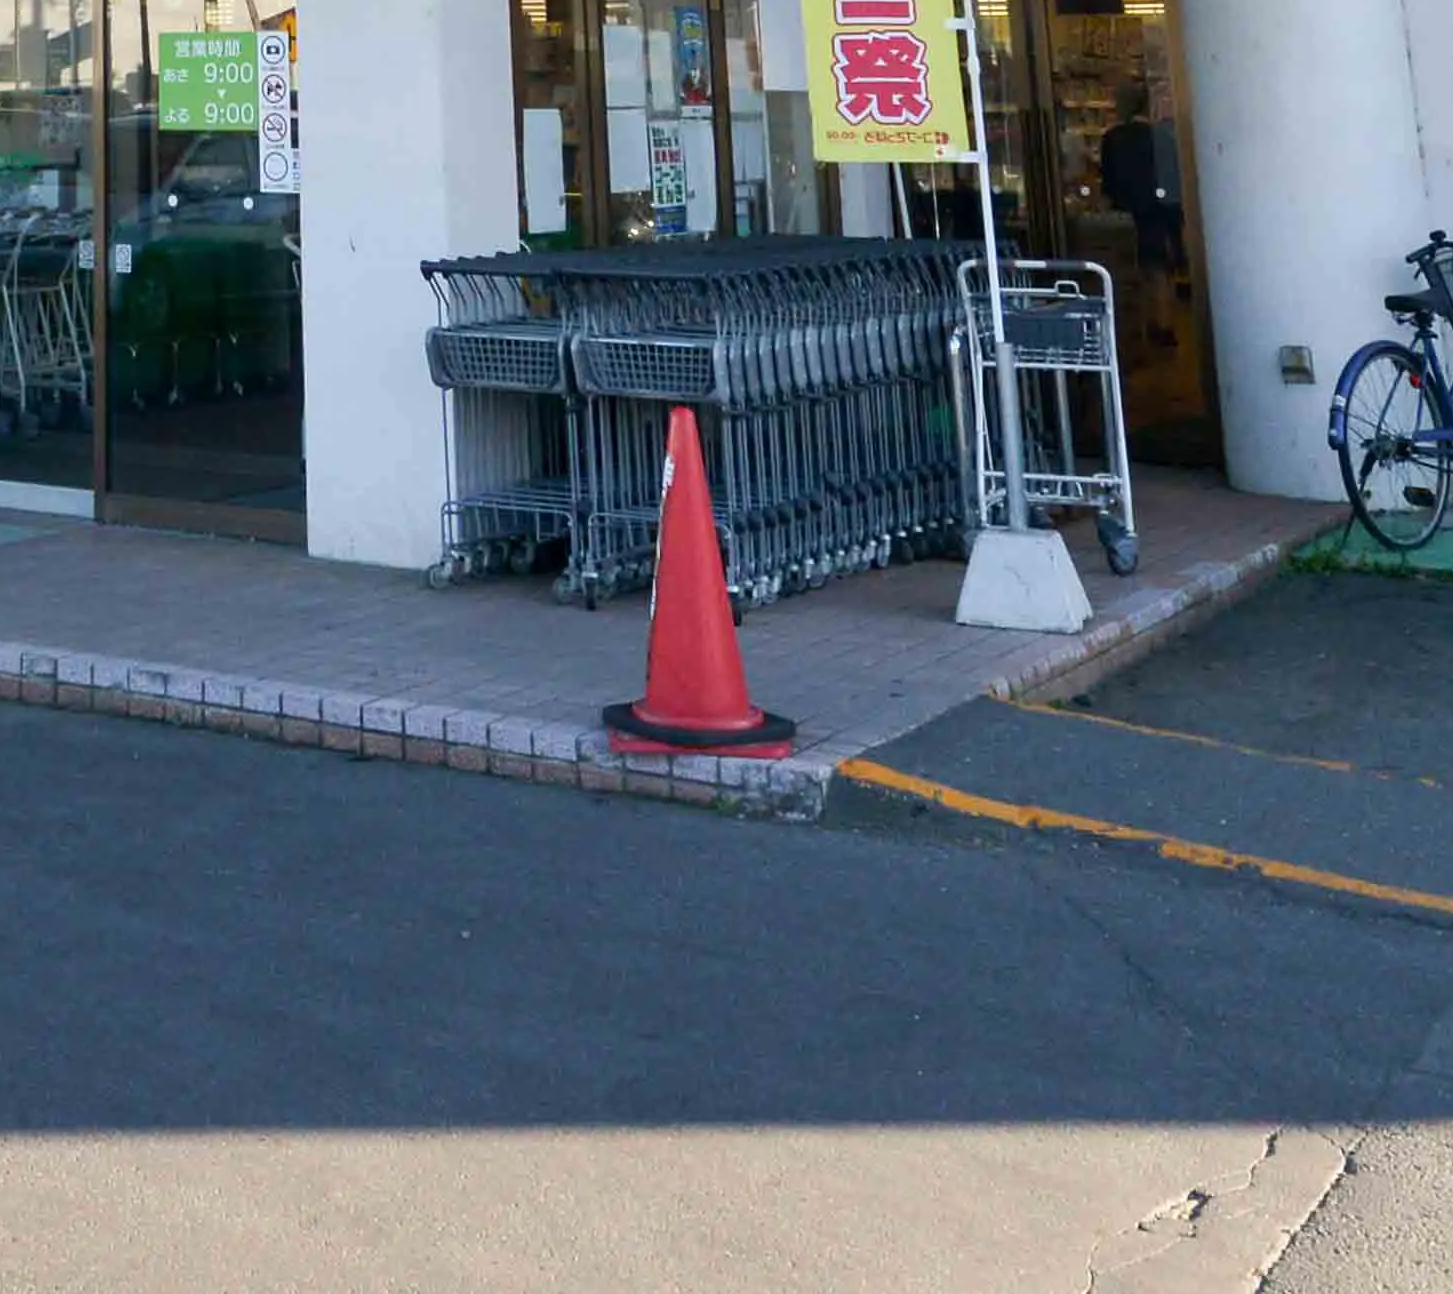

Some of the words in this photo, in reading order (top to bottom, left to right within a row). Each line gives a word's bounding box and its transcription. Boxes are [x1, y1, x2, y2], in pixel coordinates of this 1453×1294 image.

[175, 39, 241, 58] 営業時間
[164, 68, 190, 83] あさ
[203, 62, 254, 84] 9:00
[164, 107, 190, 123] よる
[204, 102, 255, 124] 9:00
